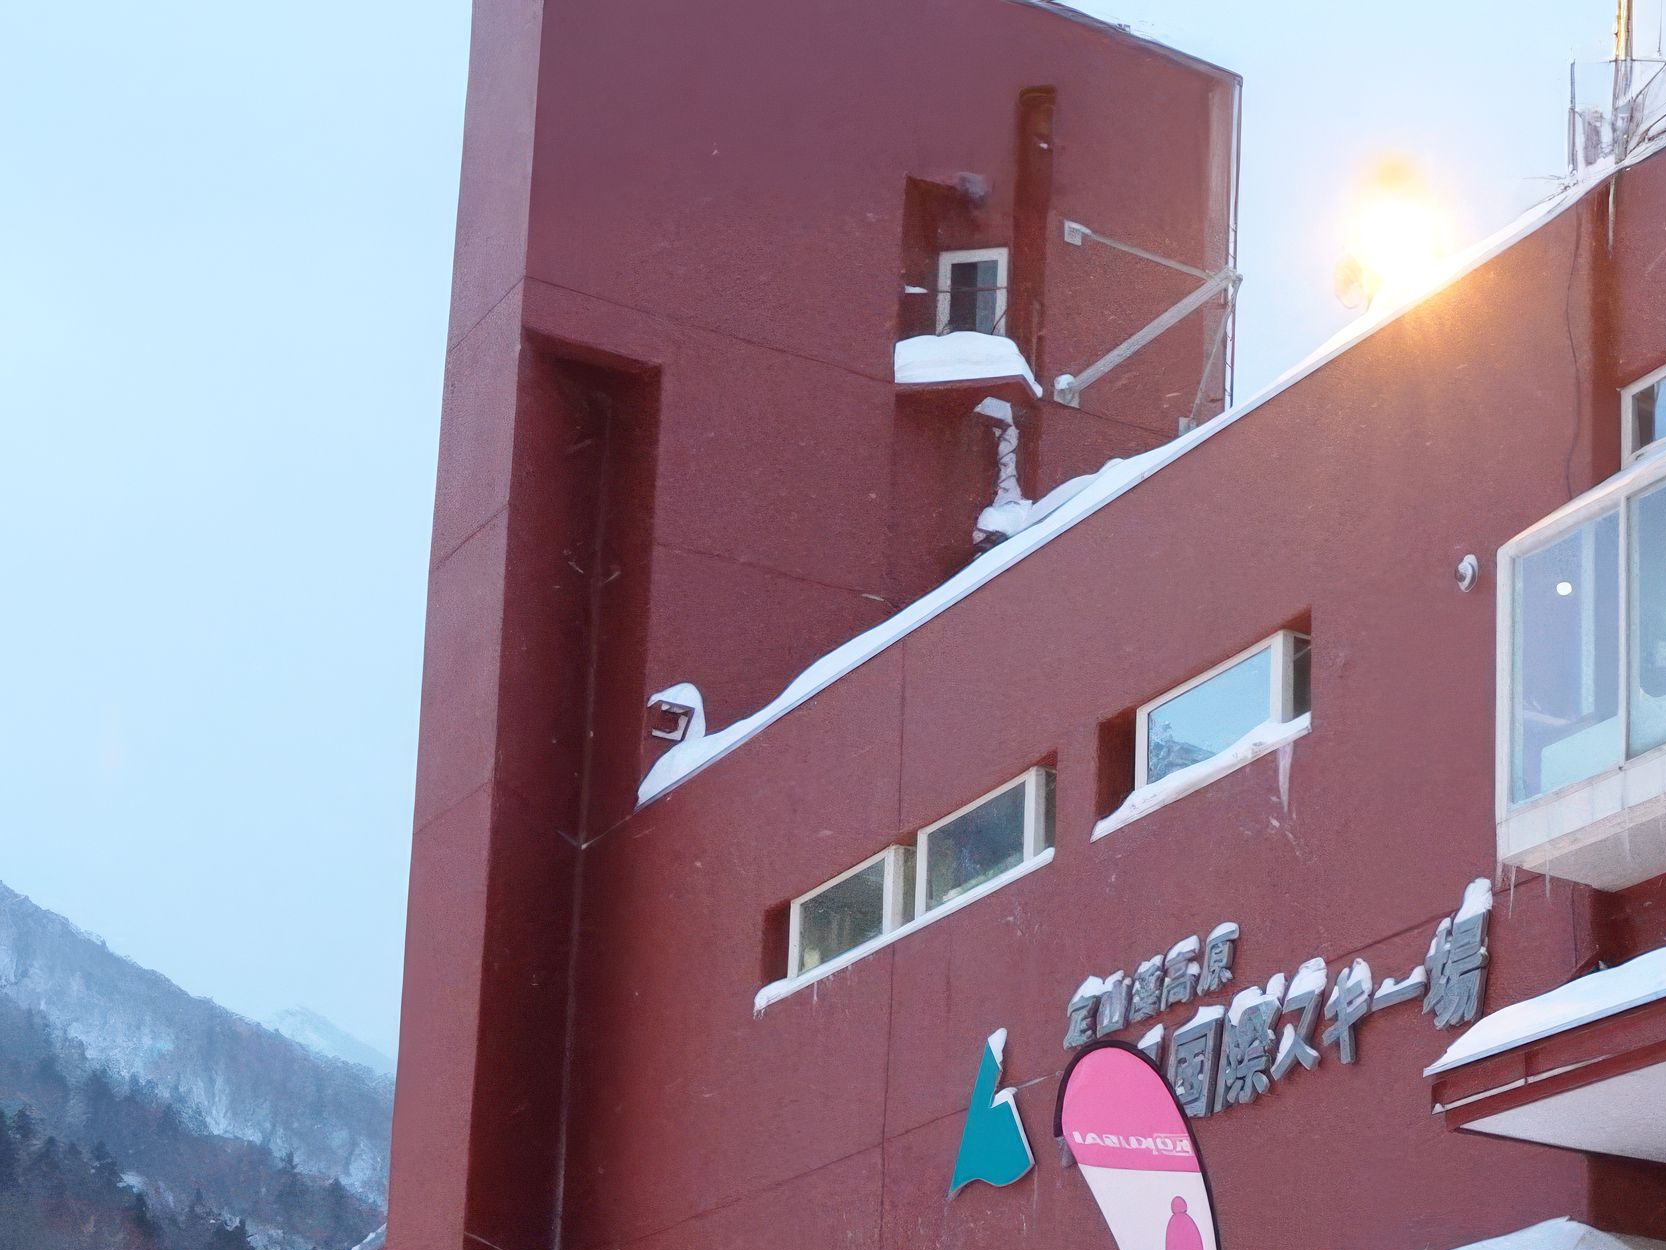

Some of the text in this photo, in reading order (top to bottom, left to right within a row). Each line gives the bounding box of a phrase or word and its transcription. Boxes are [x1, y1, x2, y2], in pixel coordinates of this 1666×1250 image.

[1138, 877, 1494, 1119] 国際スキー場
